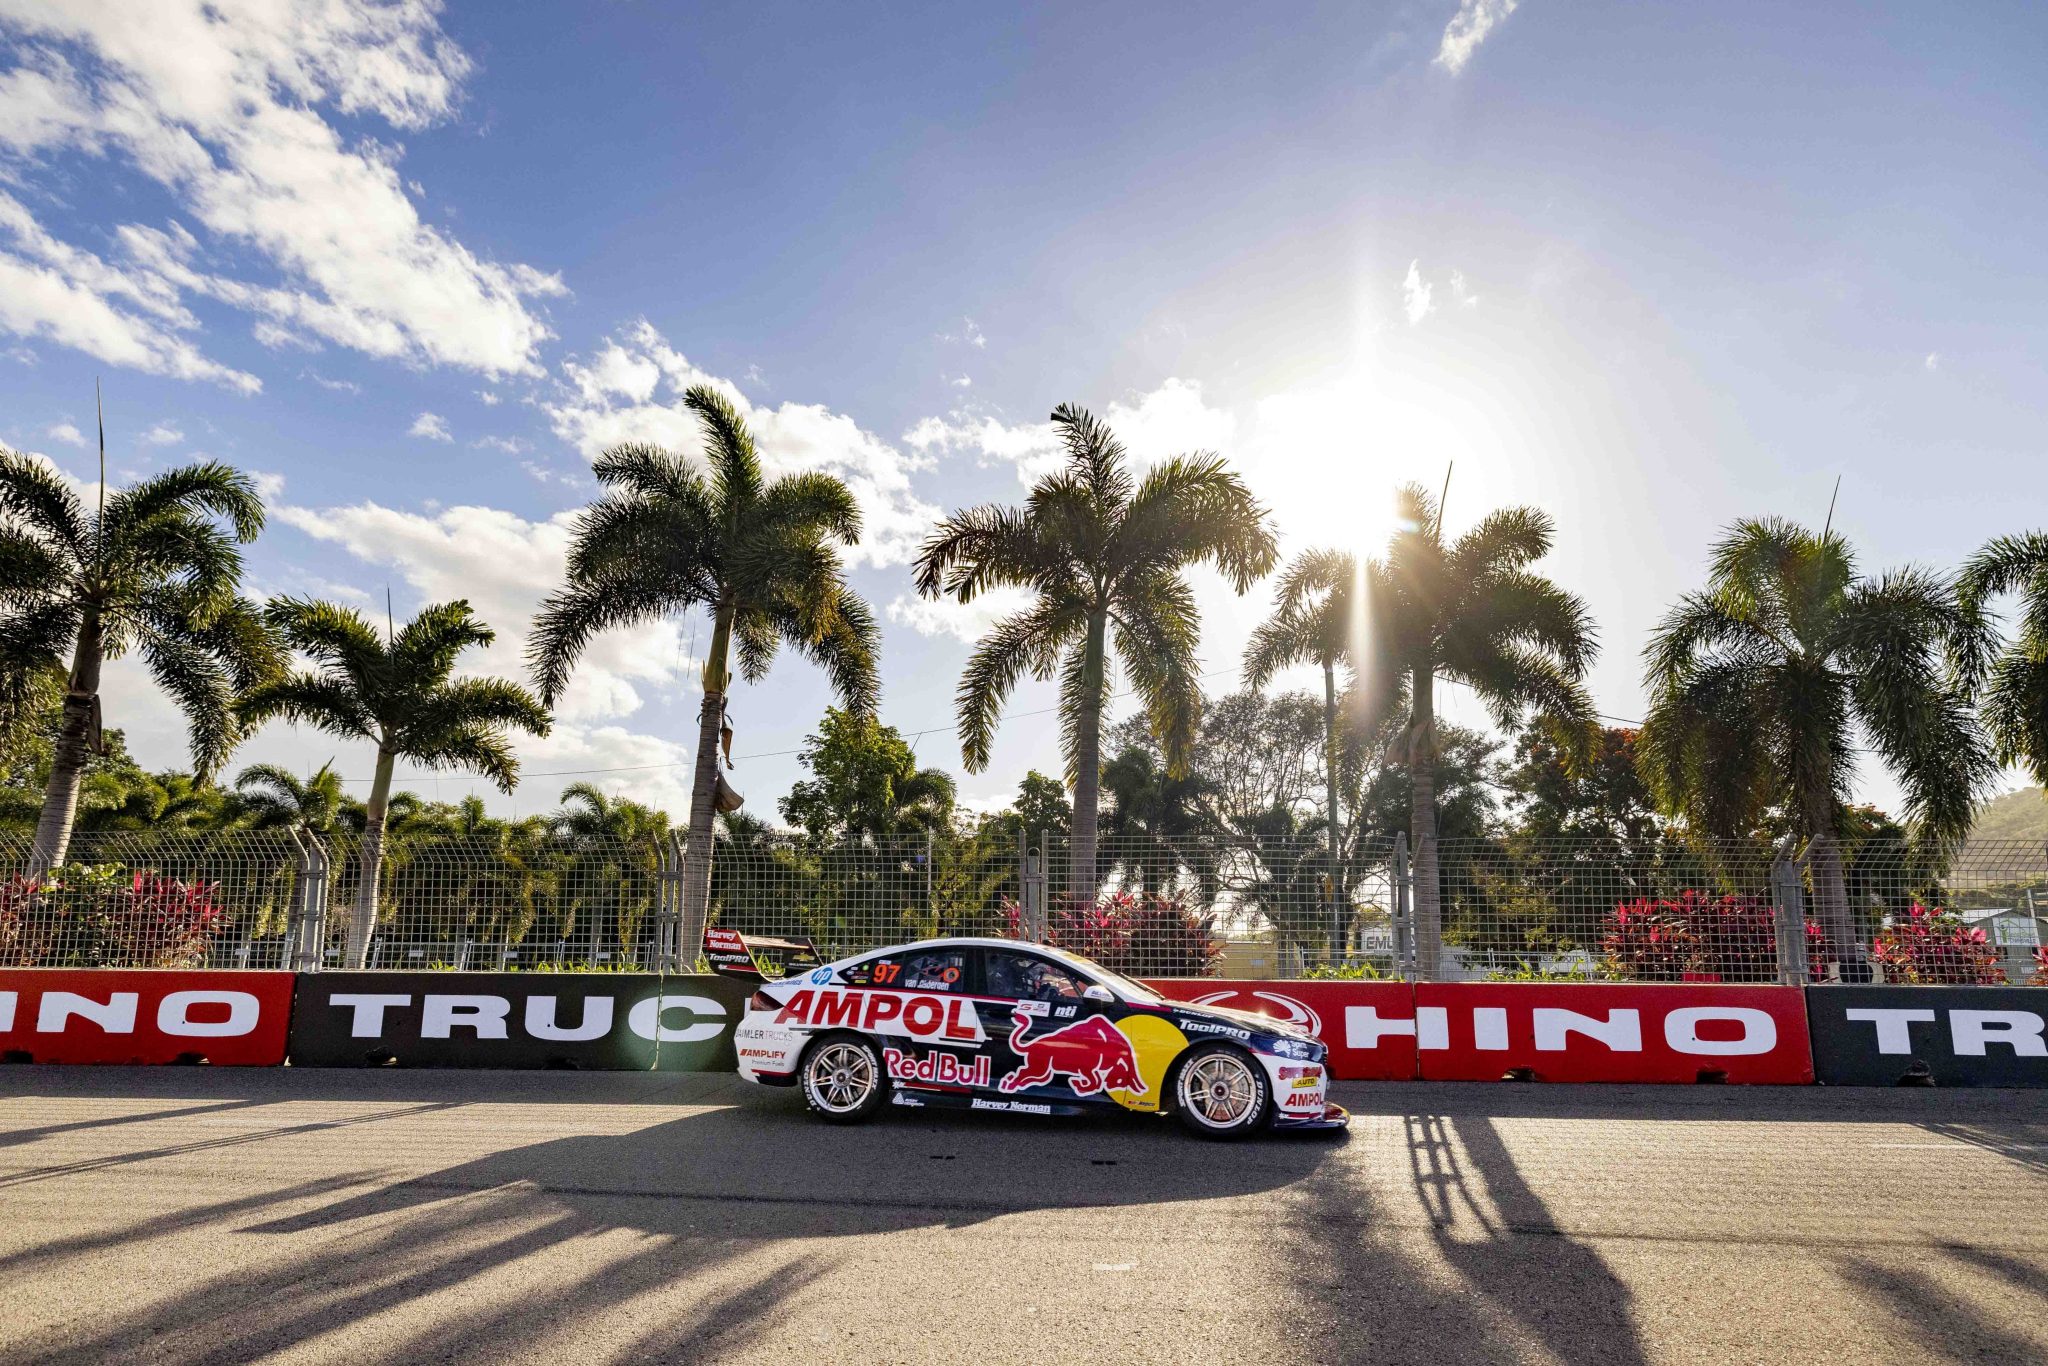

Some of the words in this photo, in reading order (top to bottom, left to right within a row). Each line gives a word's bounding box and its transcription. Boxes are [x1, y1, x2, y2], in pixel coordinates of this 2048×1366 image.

[707, 929, 736, 940] Harvey
[709, 940, 741, 950] Norman
[709, 953, 749, 963] ToolPRO
[873, 964, 902, 984] 97
[774, 990, 977, 1040] AMPOL
[1054, 1006, 1077, 1018] nti
[1180, 1019, 1251, 1040] ToolPRO
[1346, 1007, 1776, 1055] HINO
[1846, 1009, 2048, 1056] TR
[746, 1049, 786, 1059] AMPLIFY
[883, 1048, 937, 1081] Red
[938, 1053, 991, 1086] Bull
[1296, 1078, 1315, 1086] AUTO
[971, 1098, 1008, 1110] Harvey
[1009, 1101, 1051, 1114] Norman
[1247, 1081, 1264, 1125] DUNLOP
[1284, 1092, 1323, 1106] AMPOL
